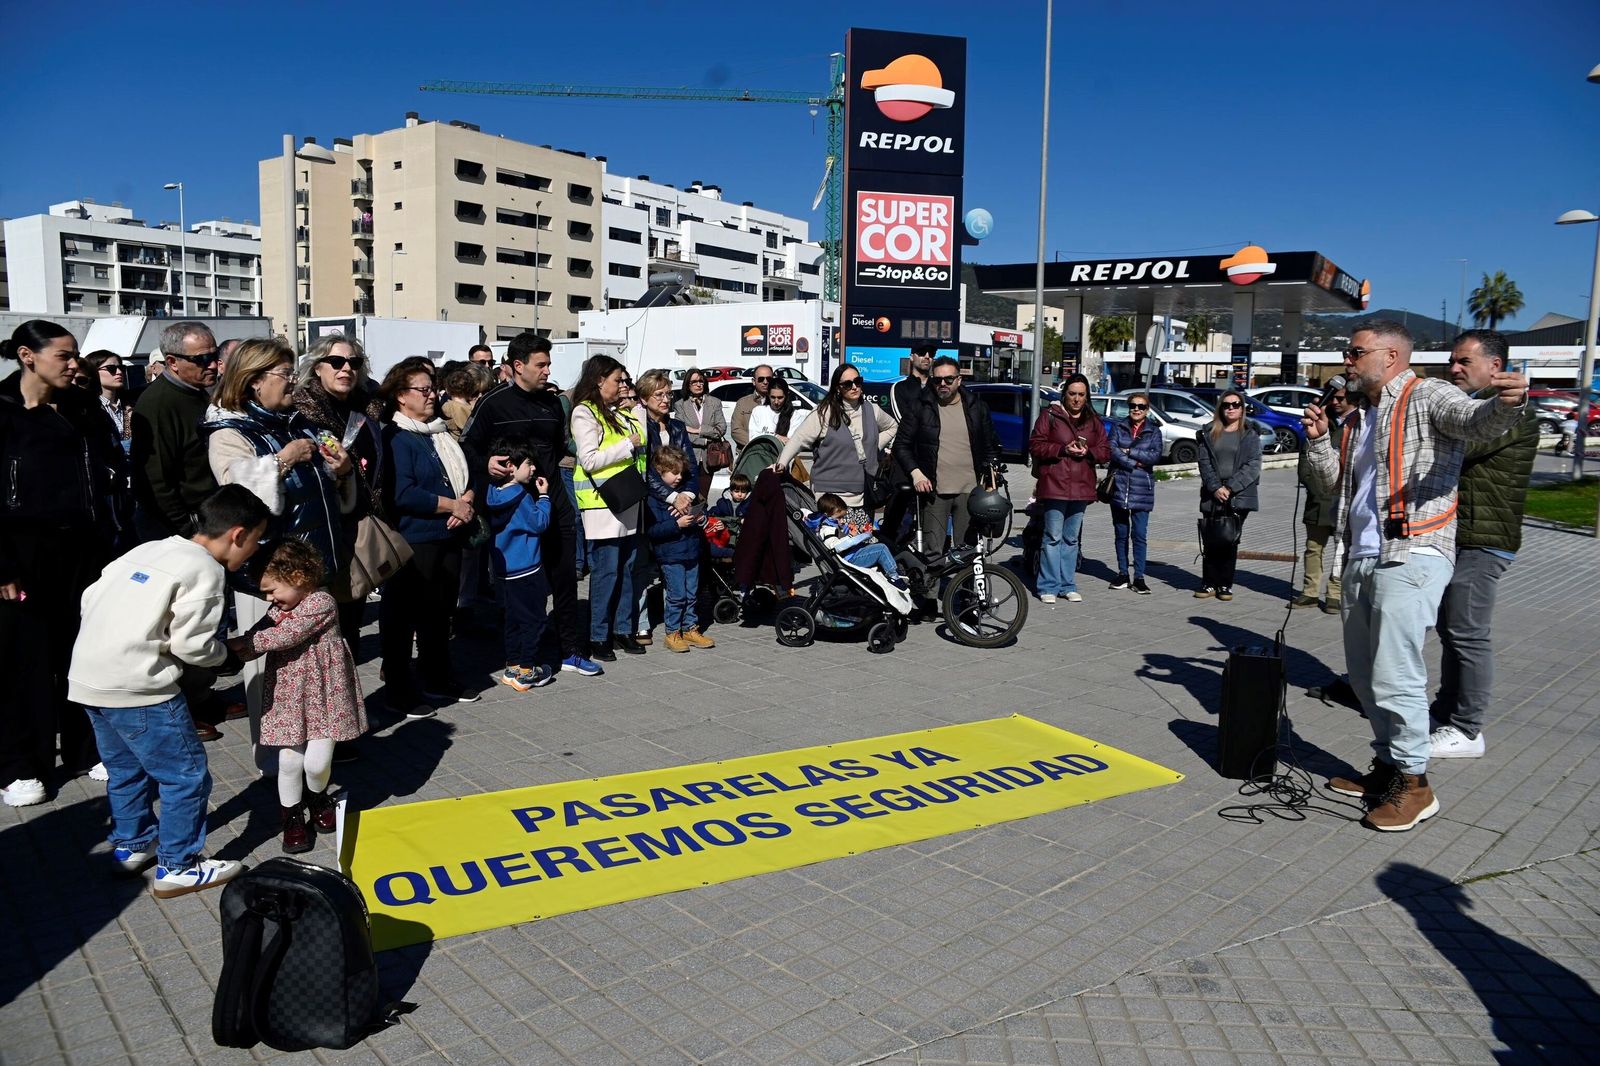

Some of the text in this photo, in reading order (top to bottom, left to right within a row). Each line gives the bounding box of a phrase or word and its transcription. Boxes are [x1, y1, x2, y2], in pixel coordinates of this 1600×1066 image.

[859, 131, 955, 154] REPSOL
[860, 198, 949, 227] SUPER
[860, 223, 948, 262] COR
[876, 264, 949, 283] Stop&Go
[1070, 260, 1190, 282] REPSOL
[769, 327, 792, 335] SUPER
[852, 317, 875, 327] Diesel
[769, 334, 791, 346] COR
[851, 355, 874, 364] Diesel
[973, 556, 986, 601] velca
[511, 746, 960, 833] PASARELAS YA
[373, 753, 1109, 906] QUEREMOS SEGURIDAD
